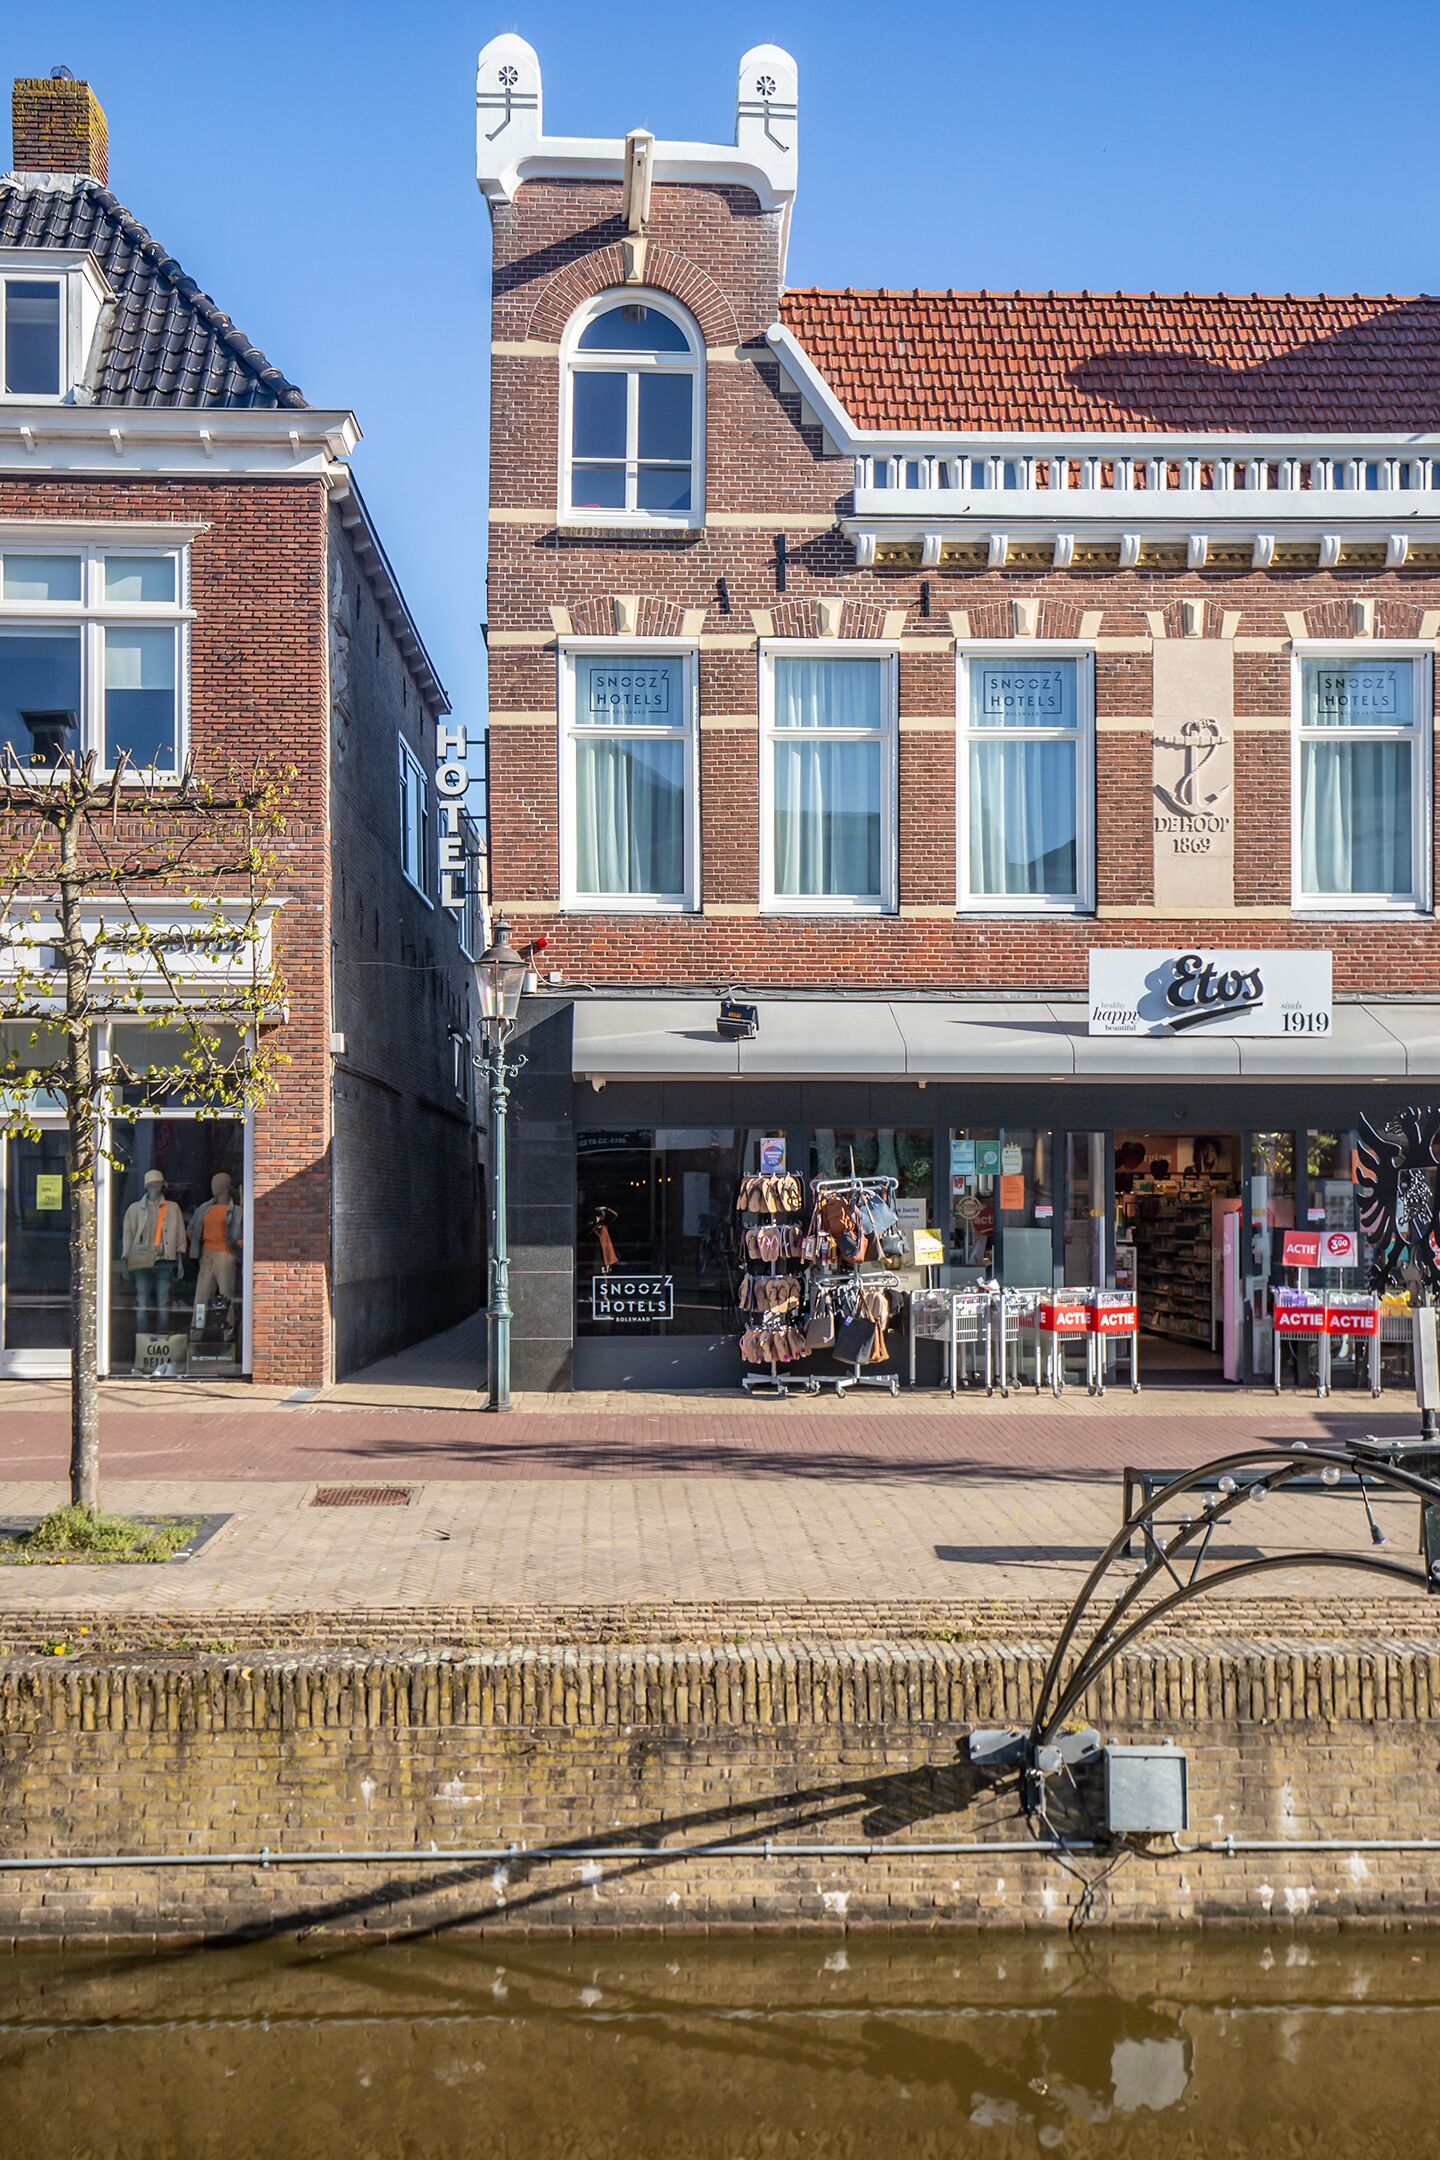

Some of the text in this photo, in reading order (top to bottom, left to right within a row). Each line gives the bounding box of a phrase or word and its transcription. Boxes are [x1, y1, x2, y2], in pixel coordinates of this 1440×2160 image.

[597, 694, 662, 705] HOTELS
[991, 696, 1055, 707] HOTELS
[1325, 695, 1389, 706] HOTELS
[435, 724, 469, 908] HOTEL
[1173, 837, 1210, 853] 1869
[1167, 954, 1264, 1007] Etos
[1281, 1001, 1303, 1009] sinds
[1092, 1006, 1140, 1024] happy
[1282, 1012, 1329, 1032] 1919
[1287, 1244, 1316, 1254] ACTIE
[600, 1301, 666, 1313] HOTELS
[1056, 1312, 1091, 1325] ACTIE
[1100, 1312, 1135, 1326] ACTIE
[1279, 1313, 1323, 1325] ACTIE
[1329, 1316, 1374, 1328] ACTIE
[147, 1345, 170, 1356] CIAO
